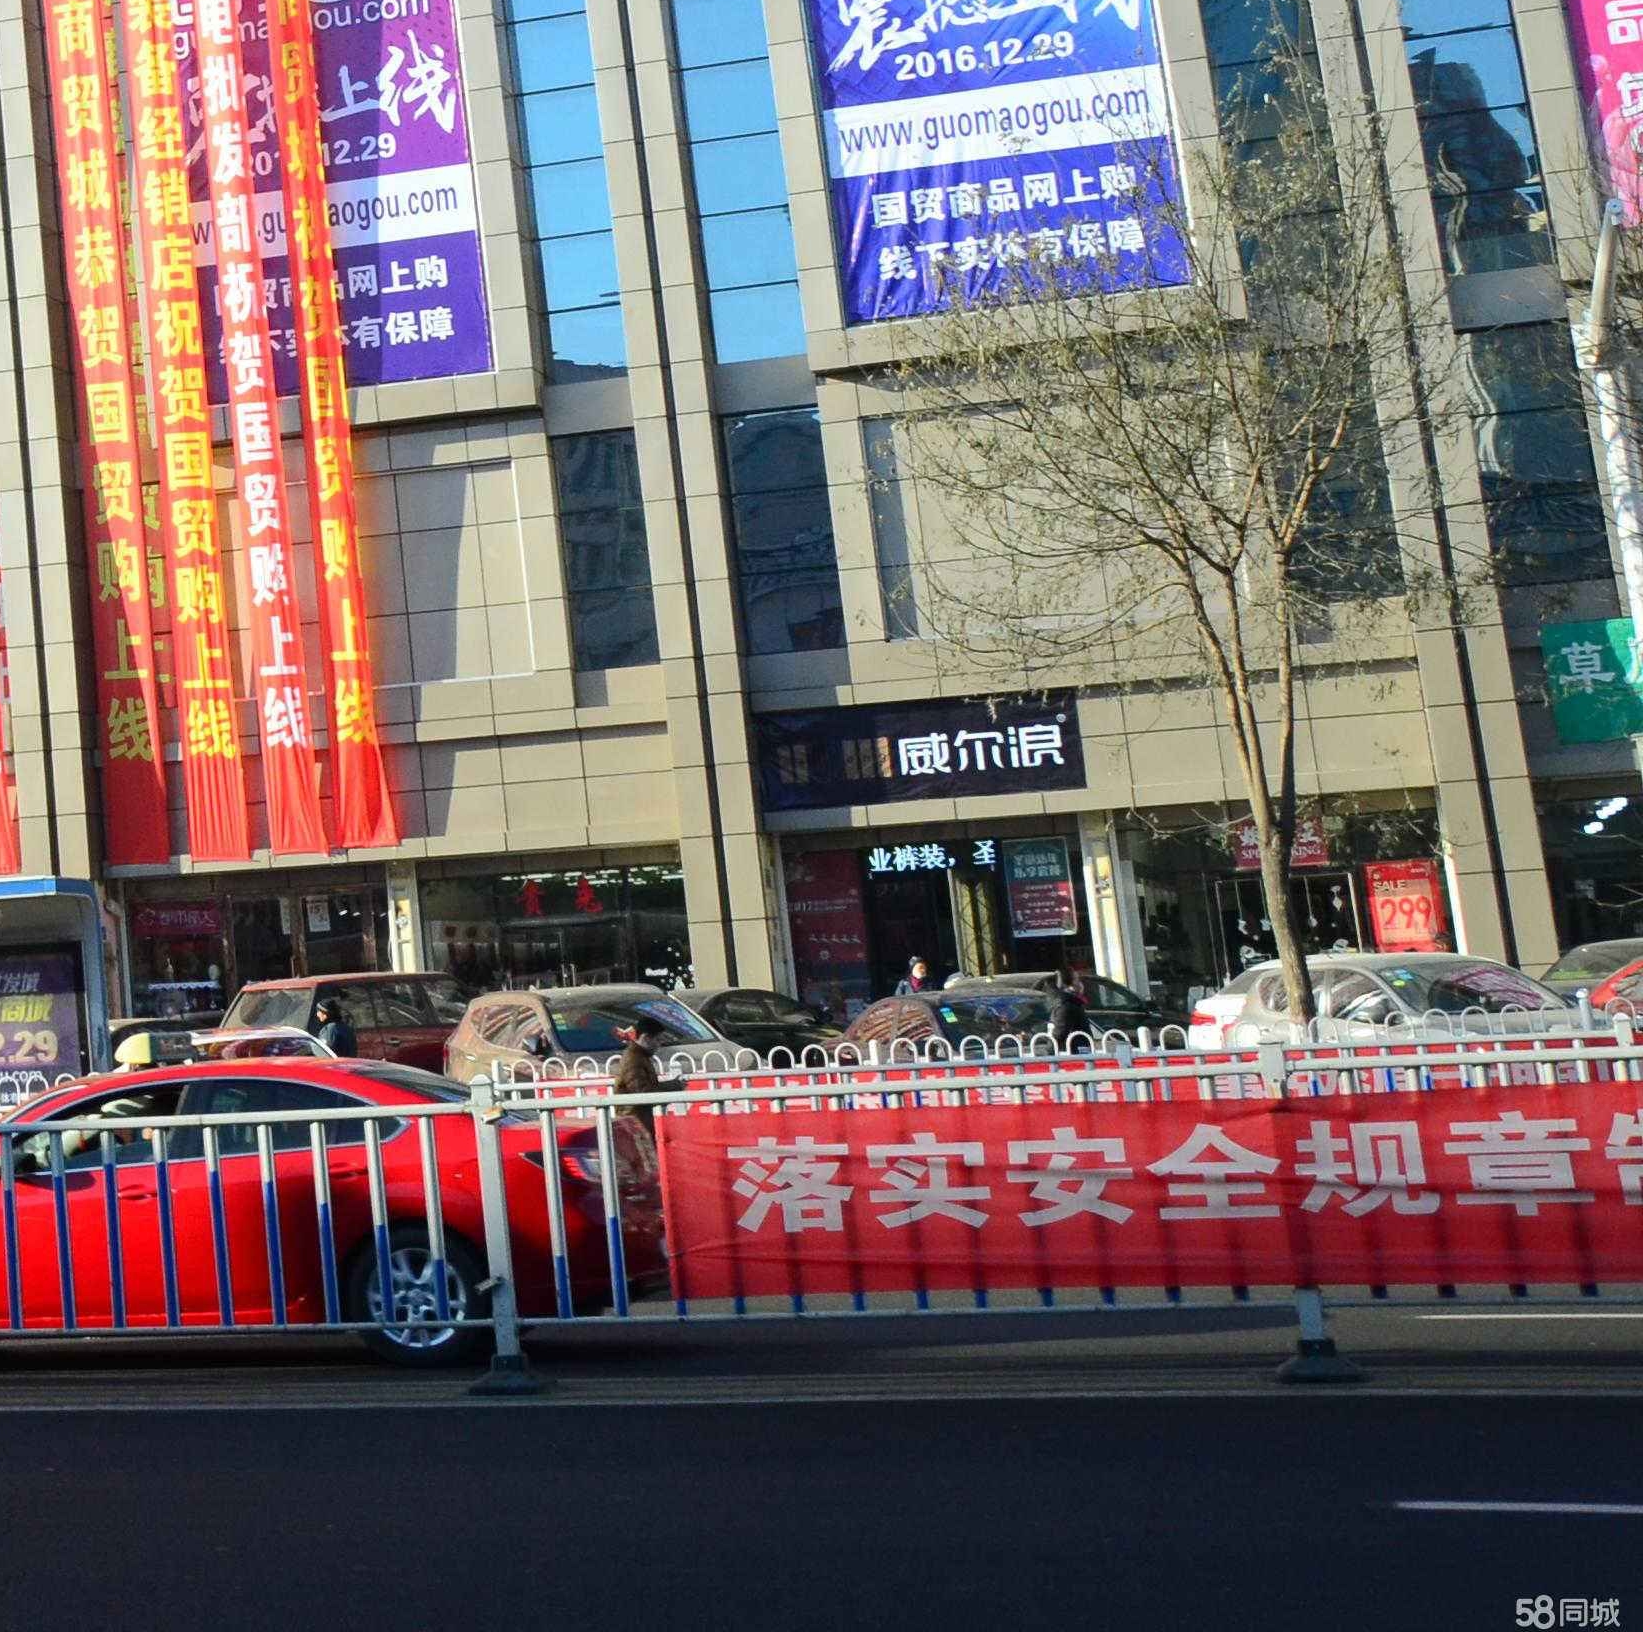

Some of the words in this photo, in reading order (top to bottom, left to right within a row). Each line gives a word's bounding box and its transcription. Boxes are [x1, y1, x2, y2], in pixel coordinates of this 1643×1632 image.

[894, 30, 1076, 82] 2016.12.29
[839, 85, 1150, 154] www.guomaogou.com
[870, 163, 1137, 229] 国贸商品网上购
[897, 723, 1066, 776] 威尔浪
[1380, 895, 1433, 930] 299
[726, 1110, 1643, 1235] 落实安全规章
